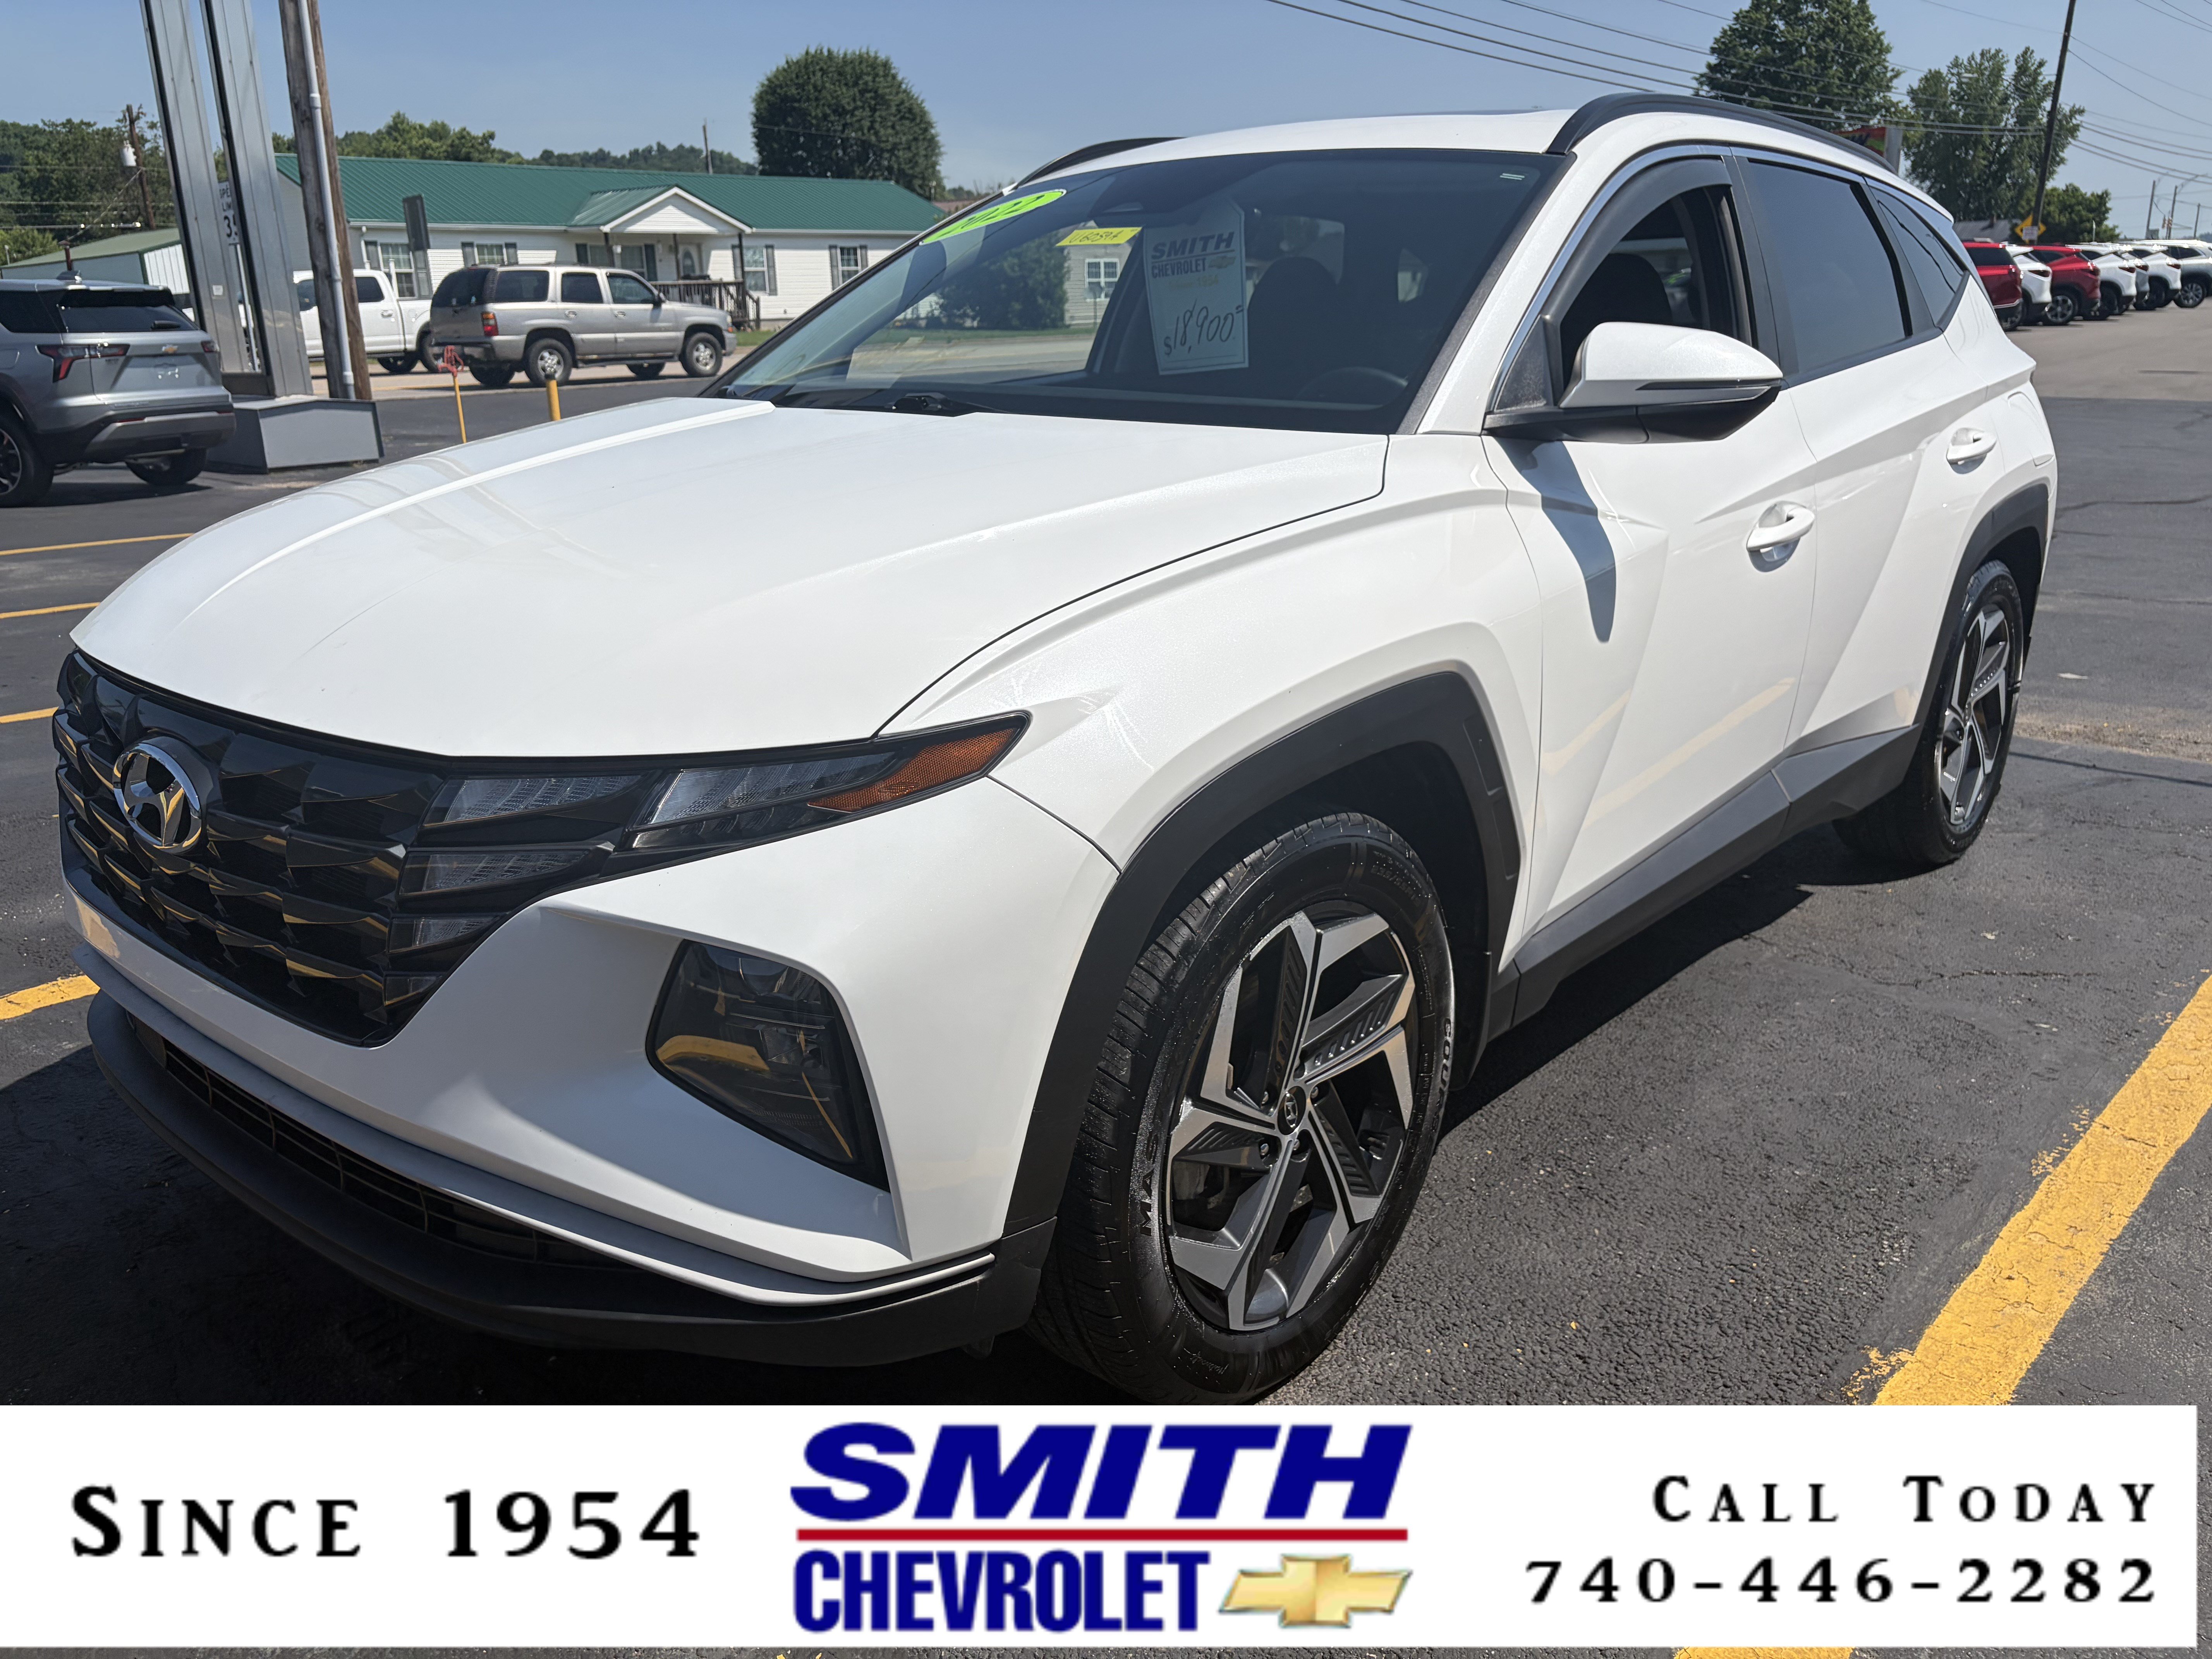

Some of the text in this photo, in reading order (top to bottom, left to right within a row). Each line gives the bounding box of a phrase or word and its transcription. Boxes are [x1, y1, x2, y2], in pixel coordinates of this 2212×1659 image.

[1151, 232, 1235, 260] SMITH
[1151, 258, 1207, 278] CHEVROLET
[1196, 274, 1219, 287] 1954
